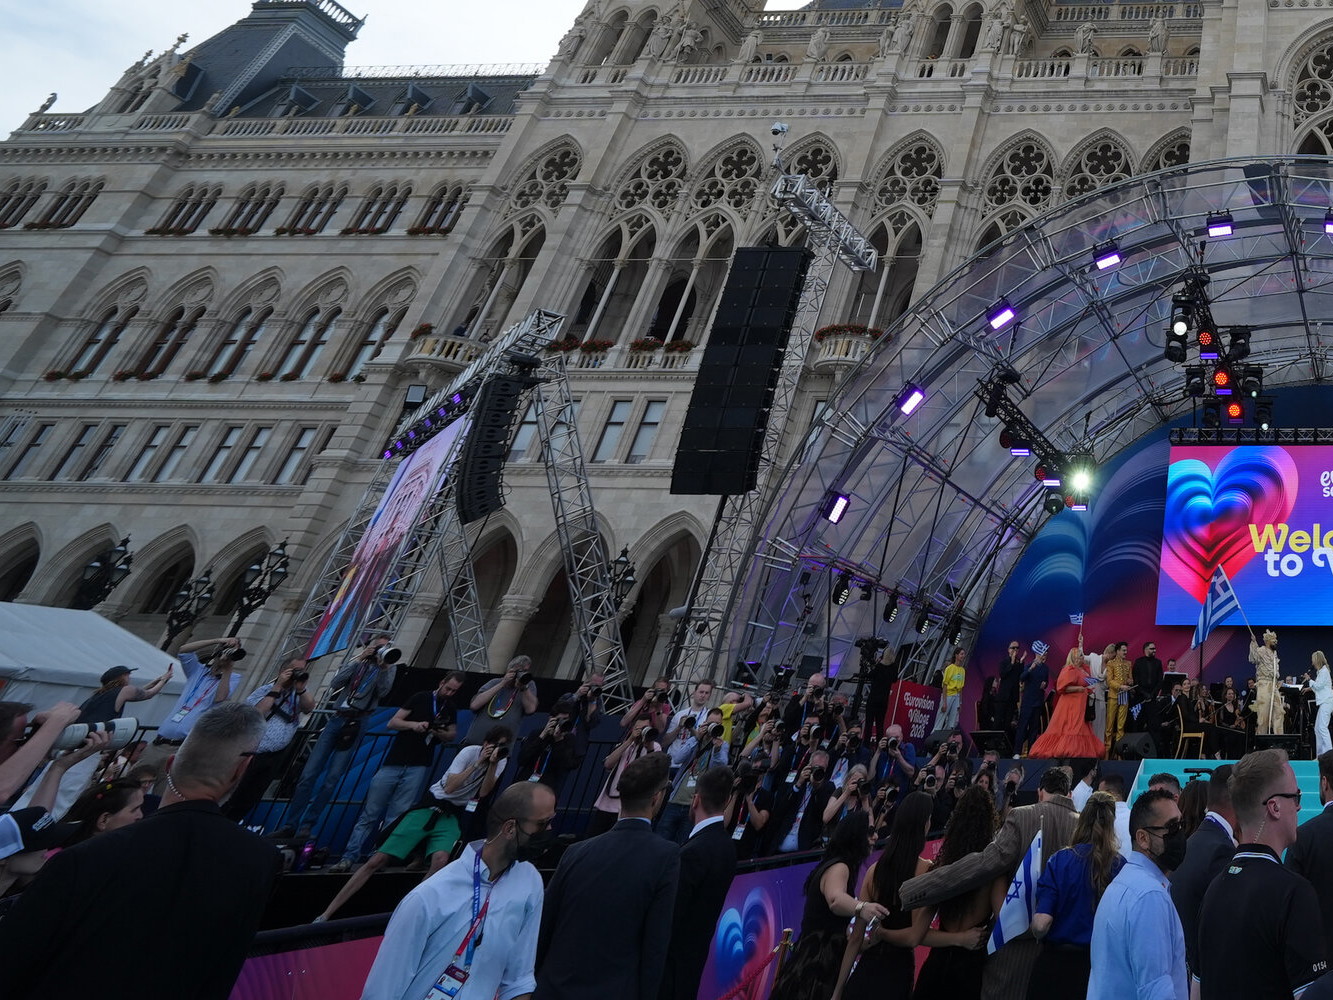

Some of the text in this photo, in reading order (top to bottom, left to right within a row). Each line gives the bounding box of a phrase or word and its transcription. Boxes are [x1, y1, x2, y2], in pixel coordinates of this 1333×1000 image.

[1264, 548, 1303, 577] to
[904, 692, 935, 710] Eurovision
[908, 708, 930, 727] Village
